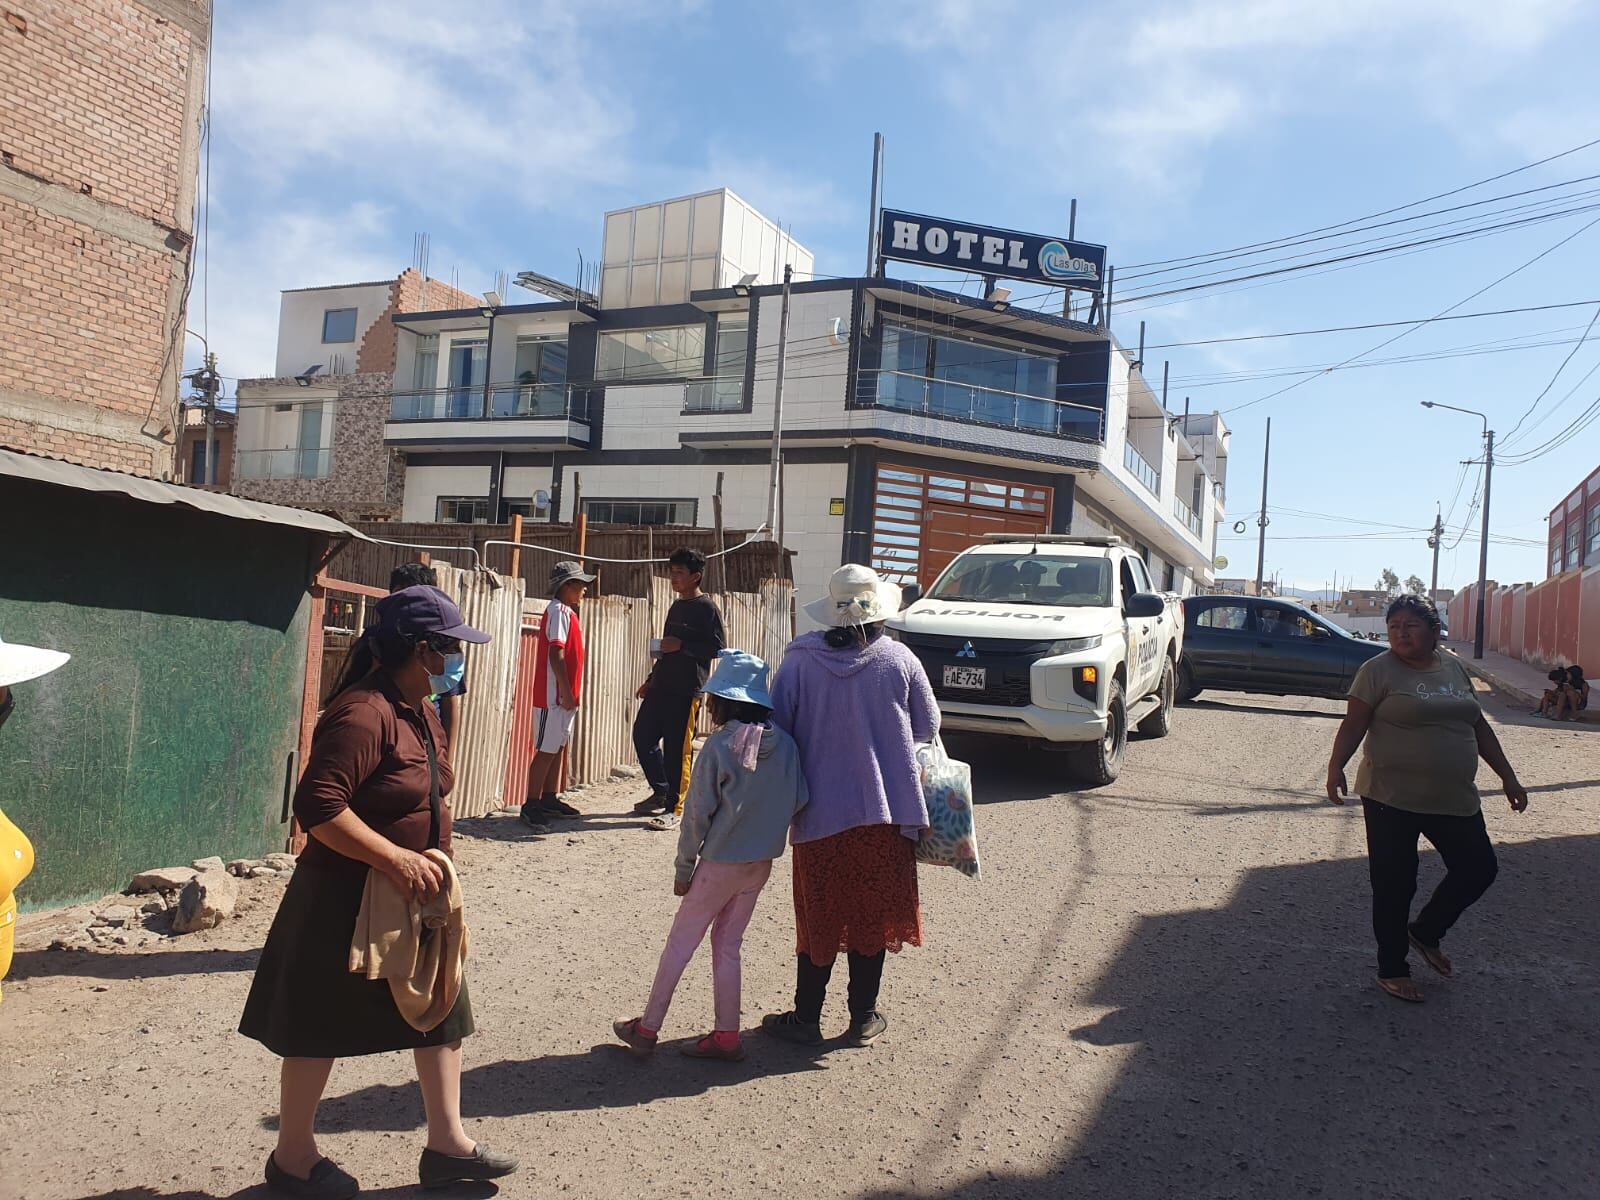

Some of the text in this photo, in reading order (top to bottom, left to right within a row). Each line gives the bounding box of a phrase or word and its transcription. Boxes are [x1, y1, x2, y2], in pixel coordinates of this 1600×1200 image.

[892, 220, 1029, 270] HOTEL
[1053, 254, 1096, 273] Las Olas
